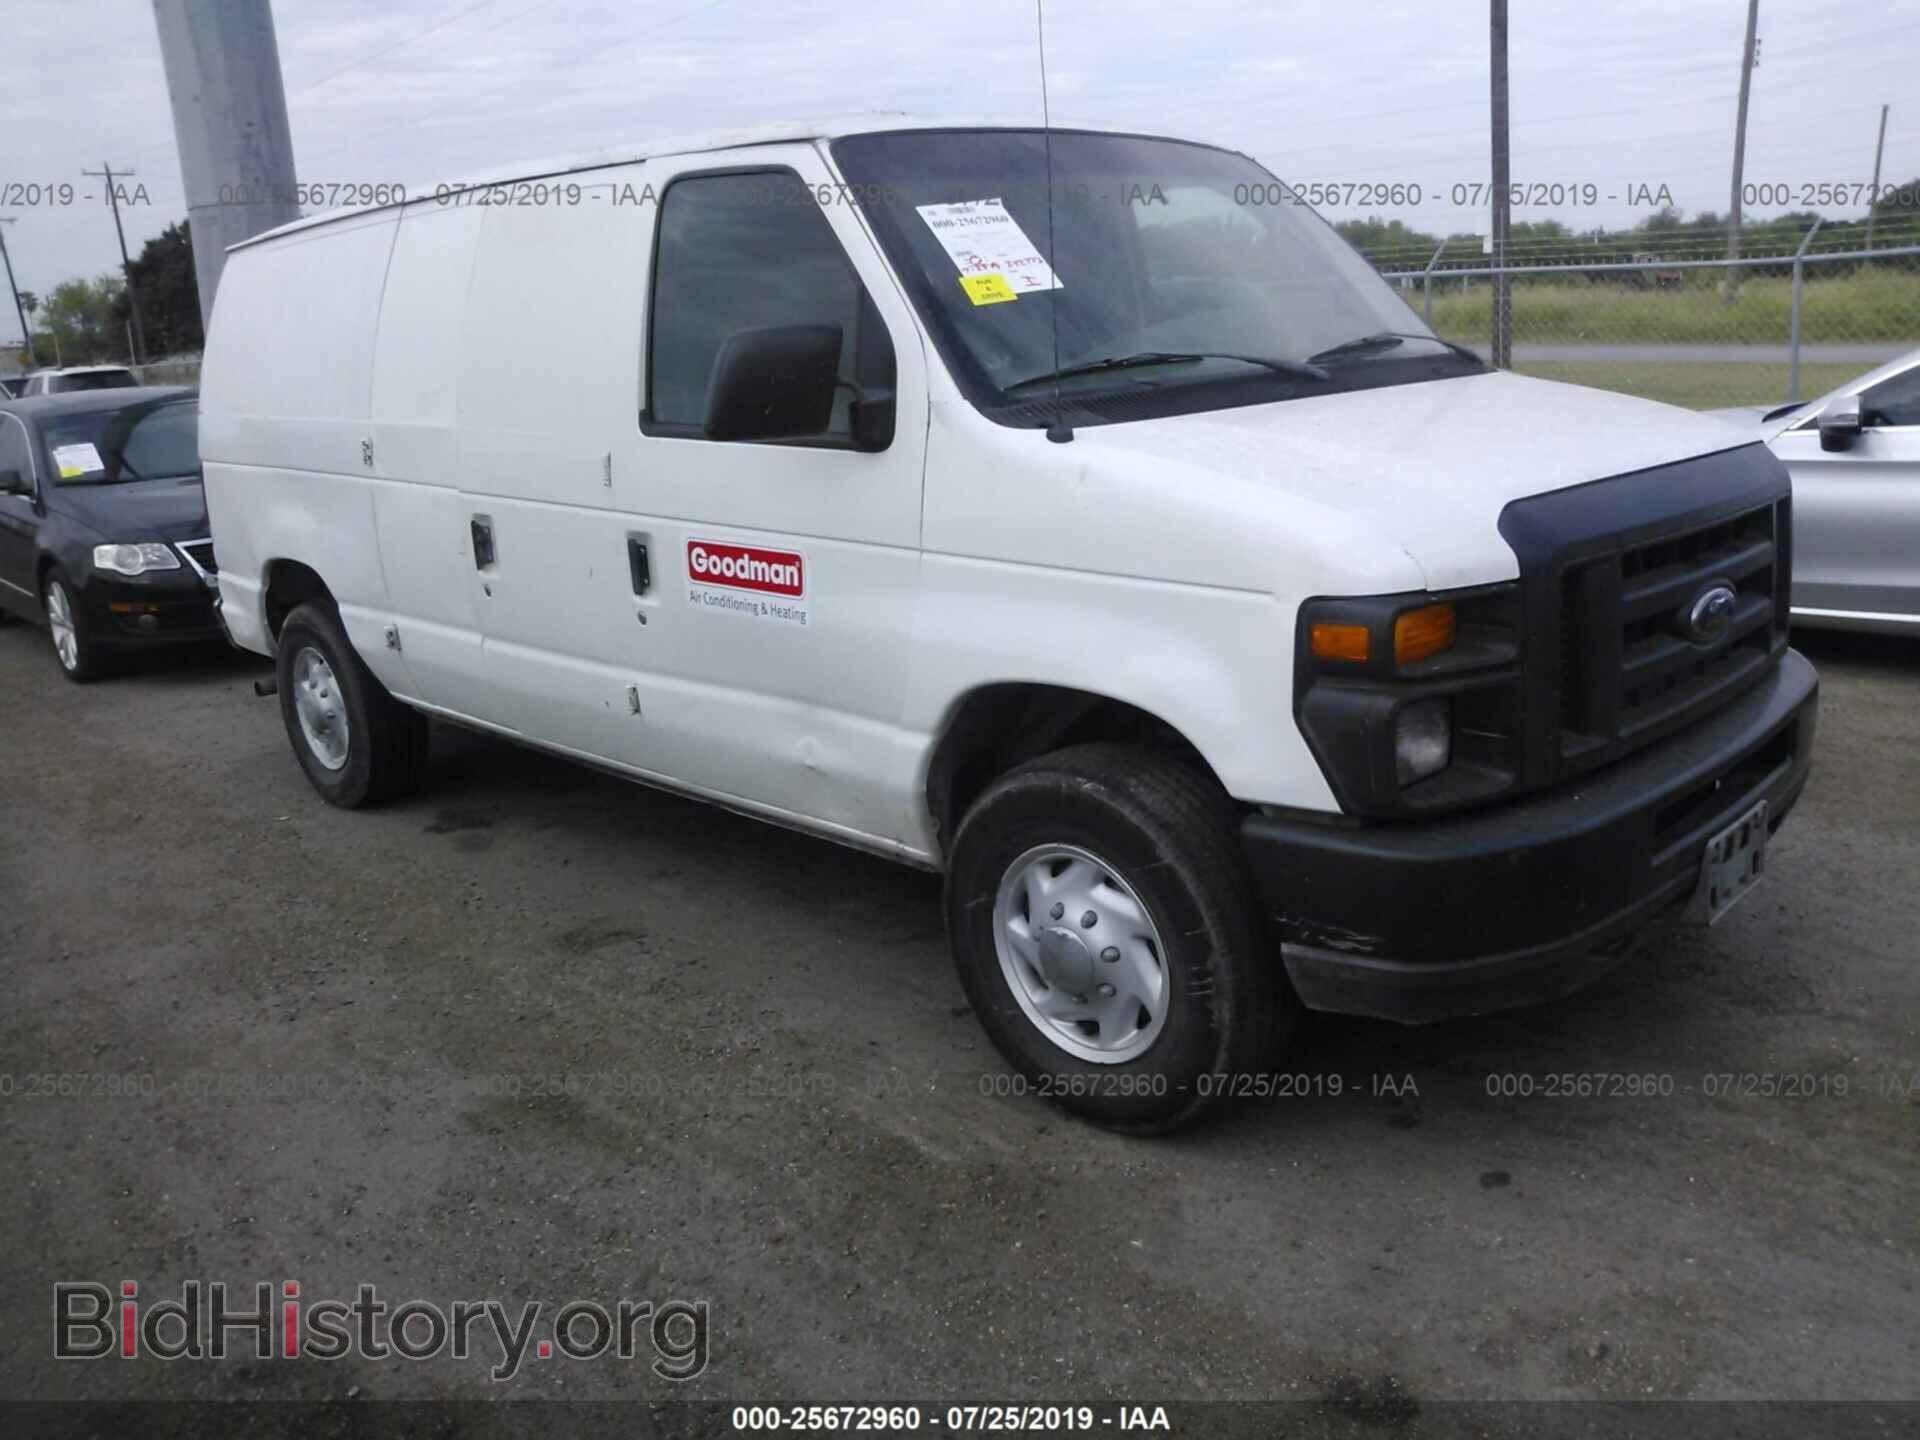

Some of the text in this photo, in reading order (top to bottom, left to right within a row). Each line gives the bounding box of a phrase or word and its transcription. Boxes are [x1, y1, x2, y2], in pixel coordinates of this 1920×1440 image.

[690, 546, 799, 588] Goodman
[690, 589, 806, 625] Air Conditioning & Heating
